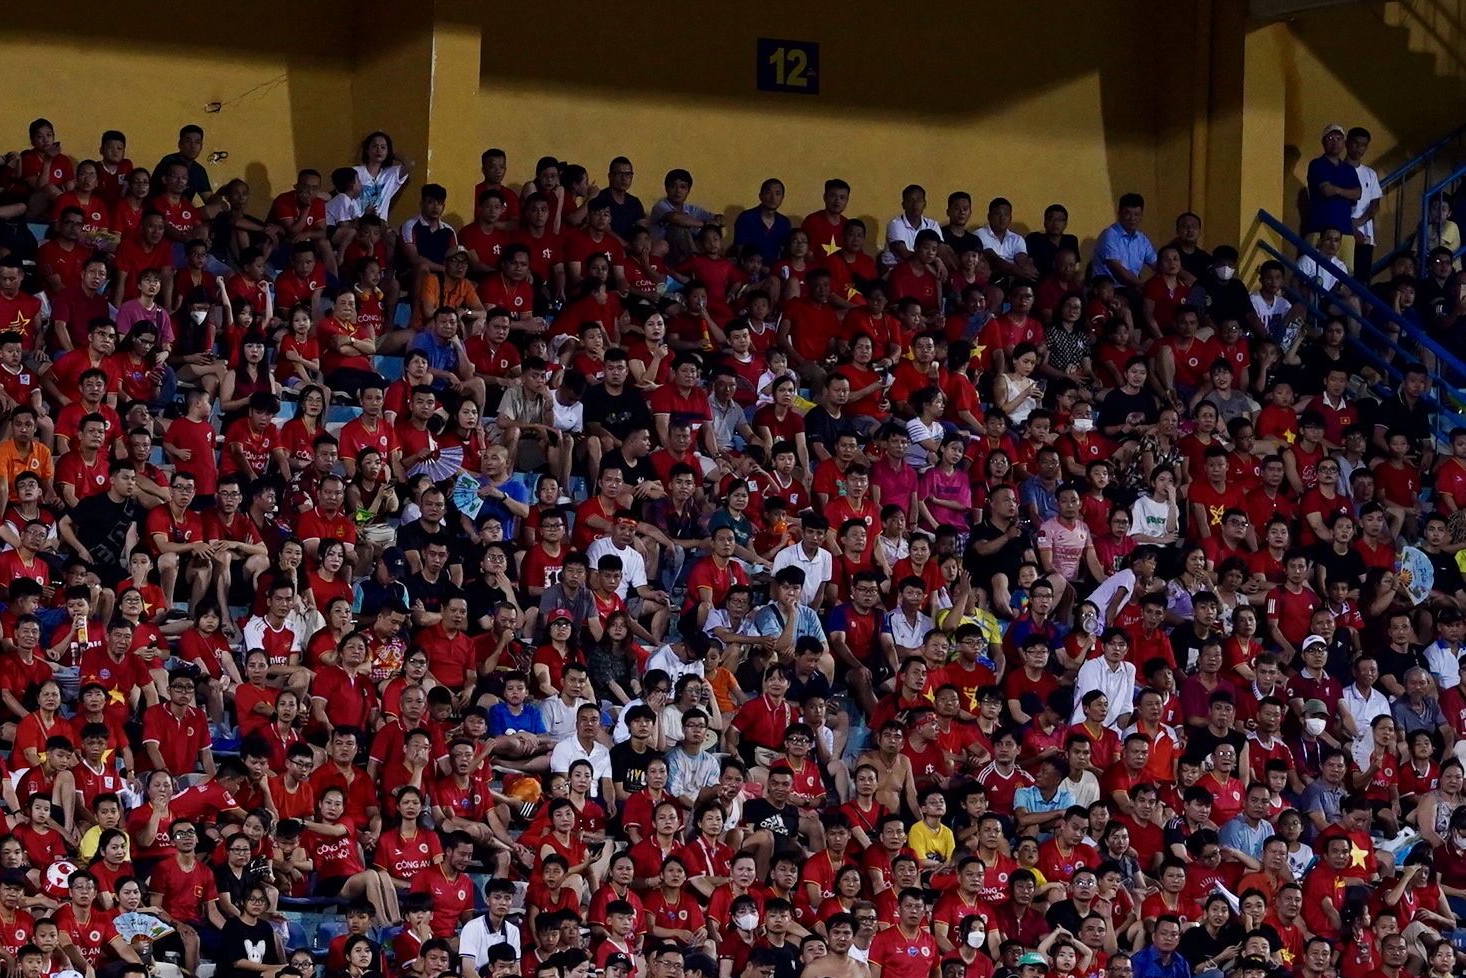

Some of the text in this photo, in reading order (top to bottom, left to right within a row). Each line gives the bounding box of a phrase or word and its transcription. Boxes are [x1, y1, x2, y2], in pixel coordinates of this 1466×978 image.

[769, 47, 808, 87] 12
[316, 838, 350, 855] CÔNG AN
[395, 859, 431, 870] CÔNG AN
